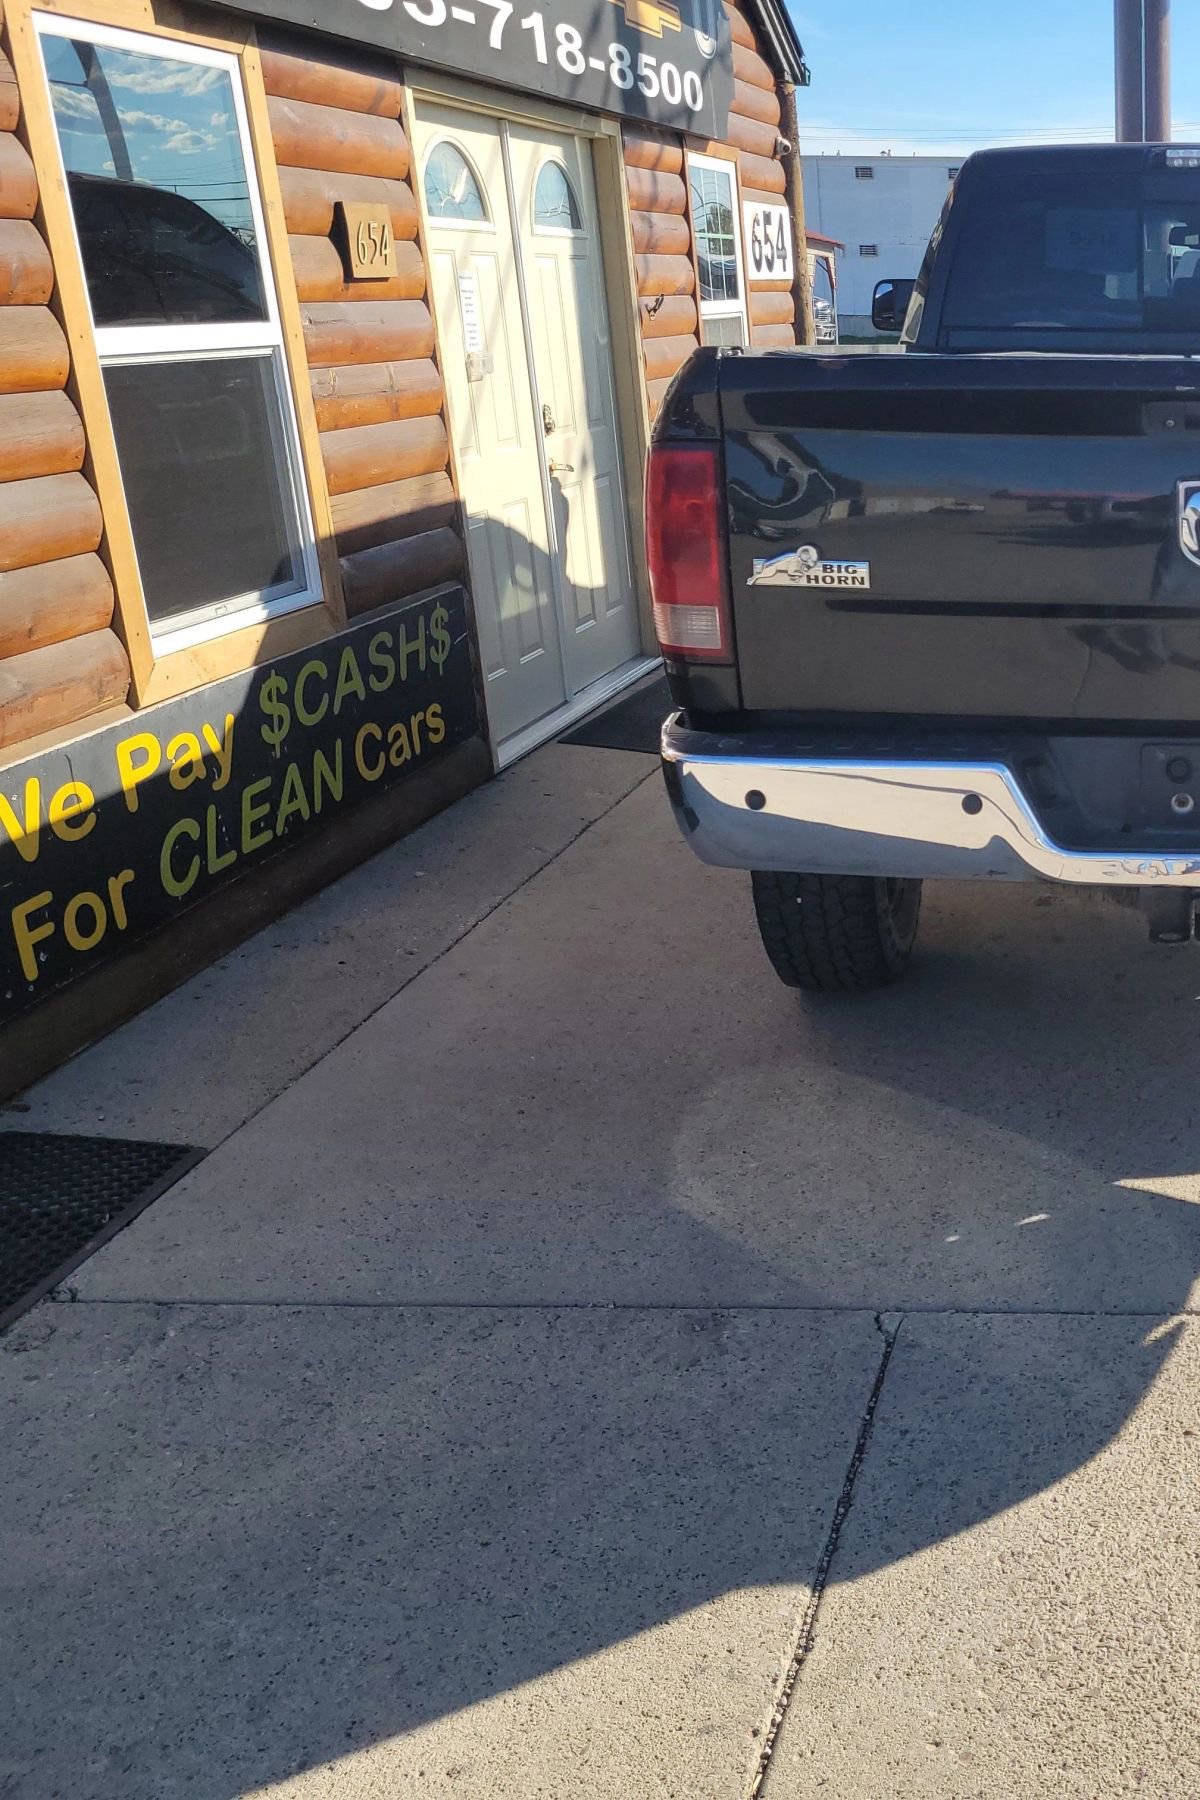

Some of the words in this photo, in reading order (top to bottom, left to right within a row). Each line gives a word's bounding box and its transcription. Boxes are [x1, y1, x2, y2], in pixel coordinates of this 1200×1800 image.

[358, 0, 703, 112] -718-8500
[356, 220, 391, 267] 654
[751, 210, 787, 273] 654
[806, 574, 865, 586] HORN
[821, 563, 858, 575] BIG
[116, 713, 235, 813] Pay
[260, 602, 451, 759] $CASH$
[12, 869, 135, 982] For
[160, 738, 343, 897] CLEAN
[355, 703, 446, 782] Cars
